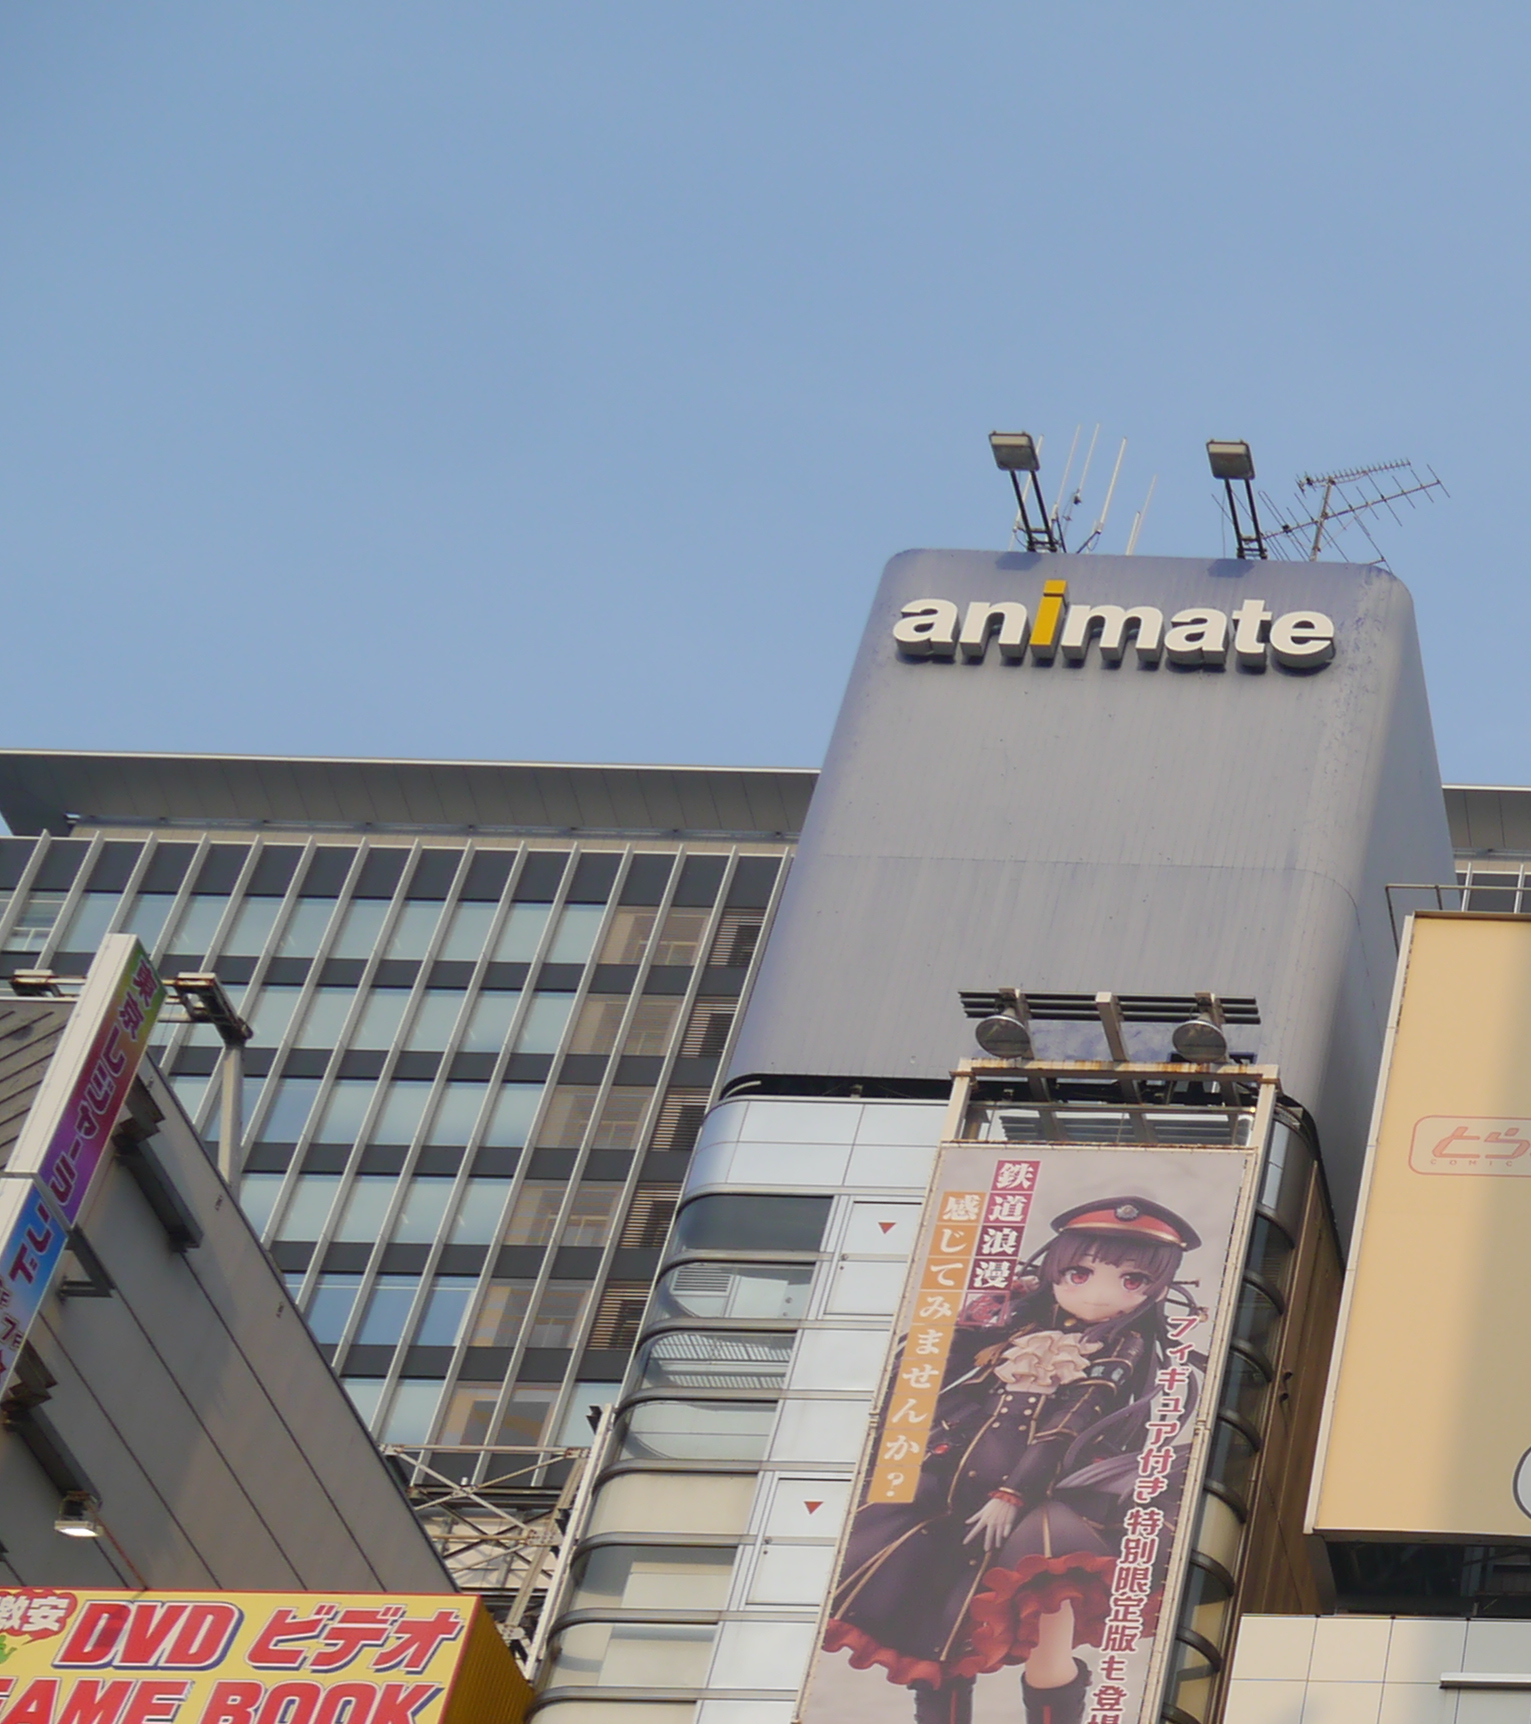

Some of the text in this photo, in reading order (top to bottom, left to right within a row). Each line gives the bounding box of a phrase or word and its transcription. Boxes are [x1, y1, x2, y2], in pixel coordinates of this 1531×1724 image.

[892, 579, 1336, 669] animate
[1431, 1158, 1514, 1167] COMIC
[966, 1161, 1037, 1324] 鉄道浪漫を
[52, 1600, 466, 1675] DVD ビデオ
